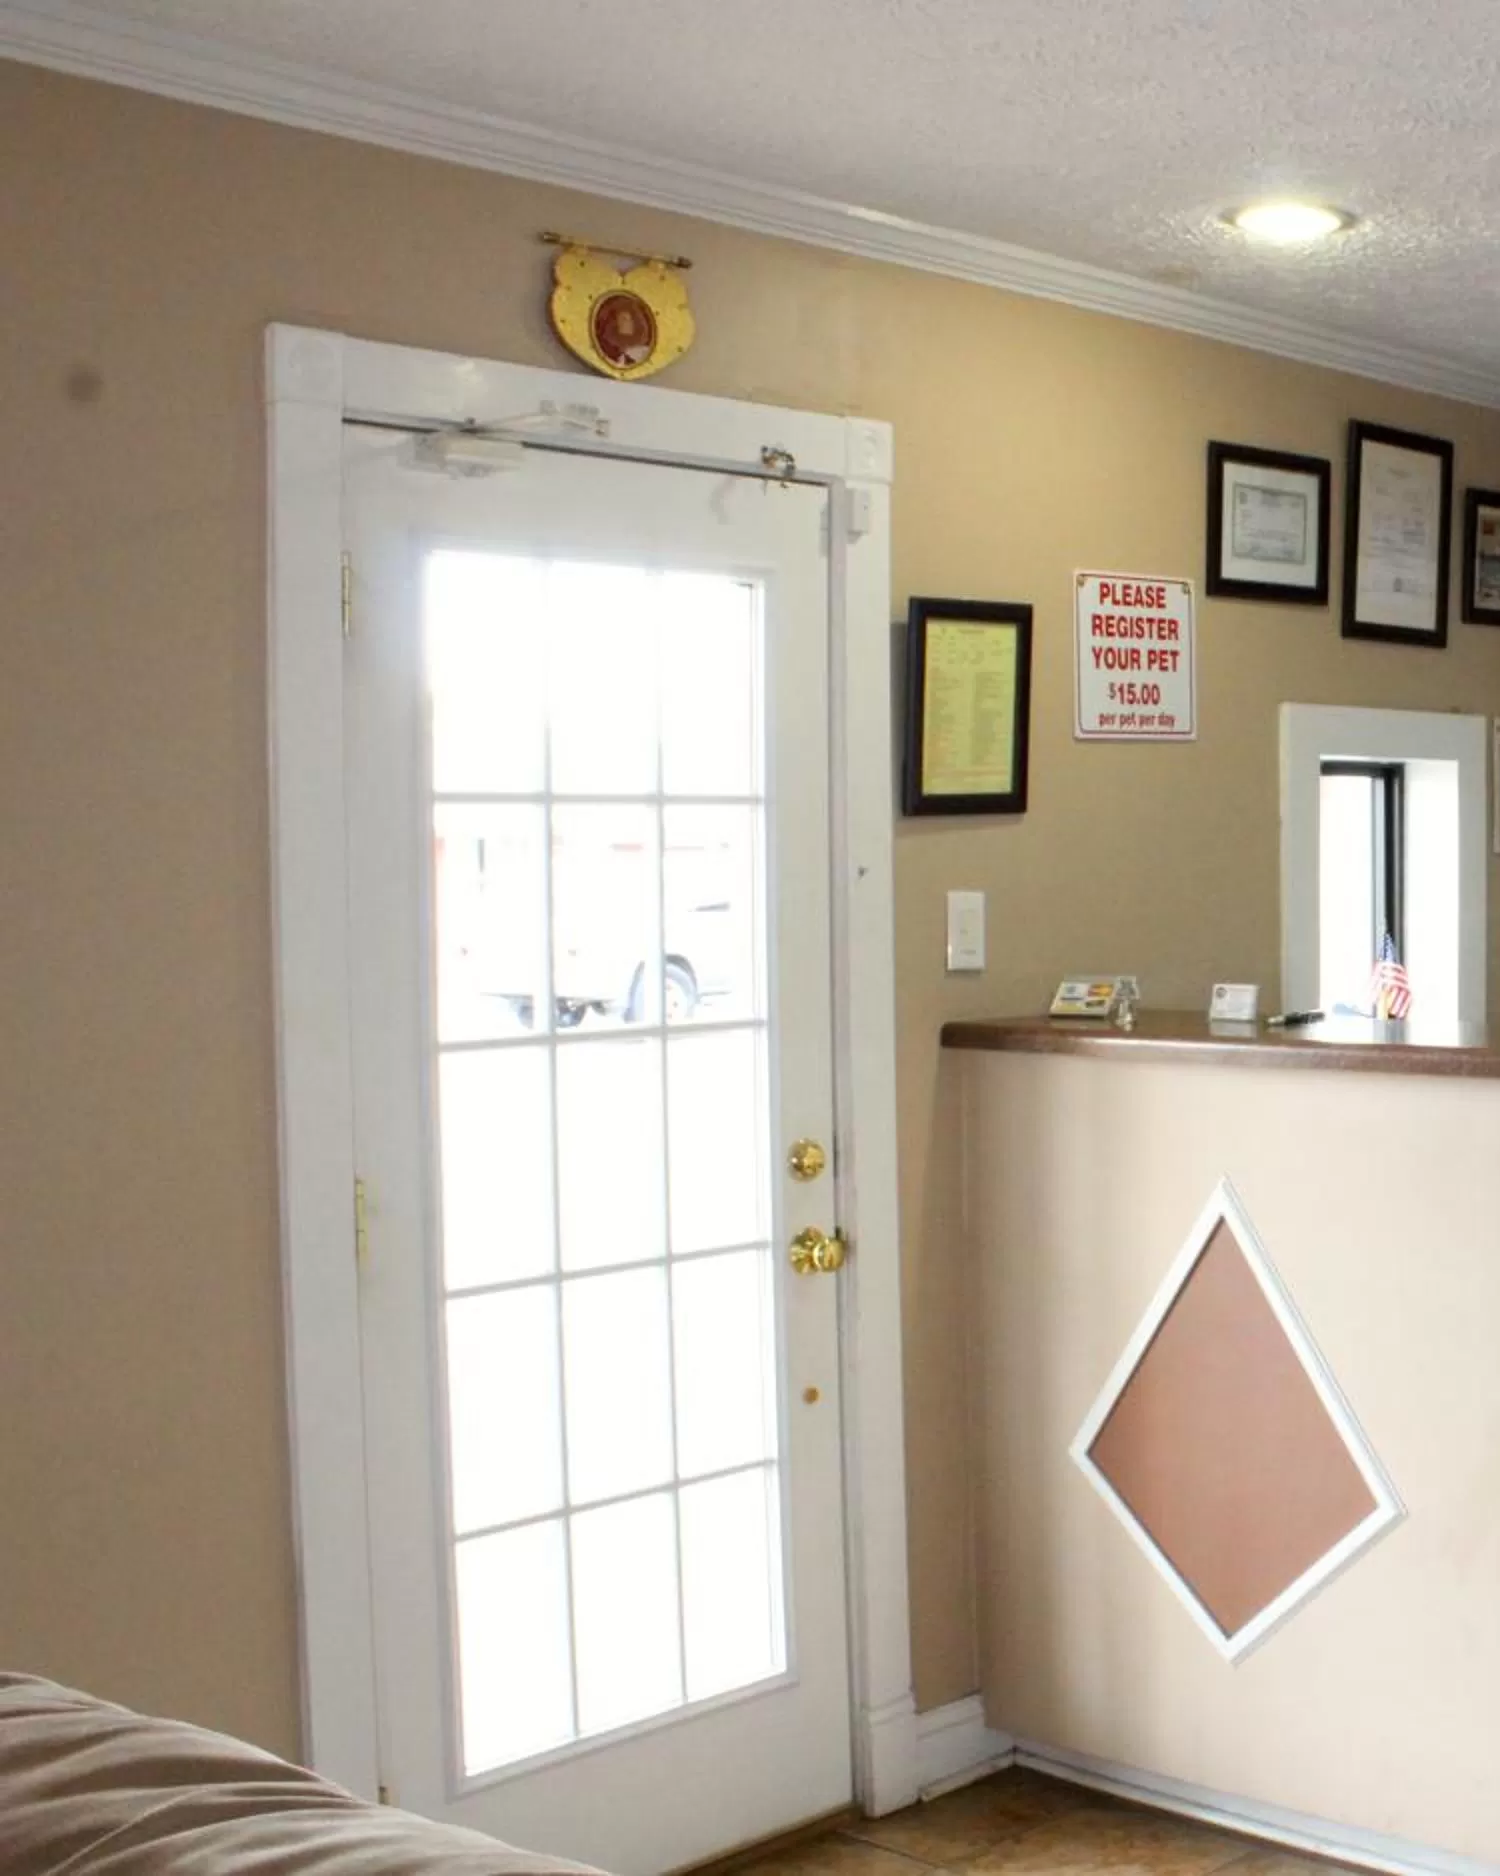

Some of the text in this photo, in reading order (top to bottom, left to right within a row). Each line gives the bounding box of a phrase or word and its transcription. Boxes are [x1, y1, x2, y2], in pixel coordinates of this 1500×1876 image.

[1099, 582, 1167, 609] PLEASE
[1091, 613, 1179, 641] REGISTER
[1091, 647, 1180, 672] YOUR PET
[1108, 681, 1161, 705] $15.00
